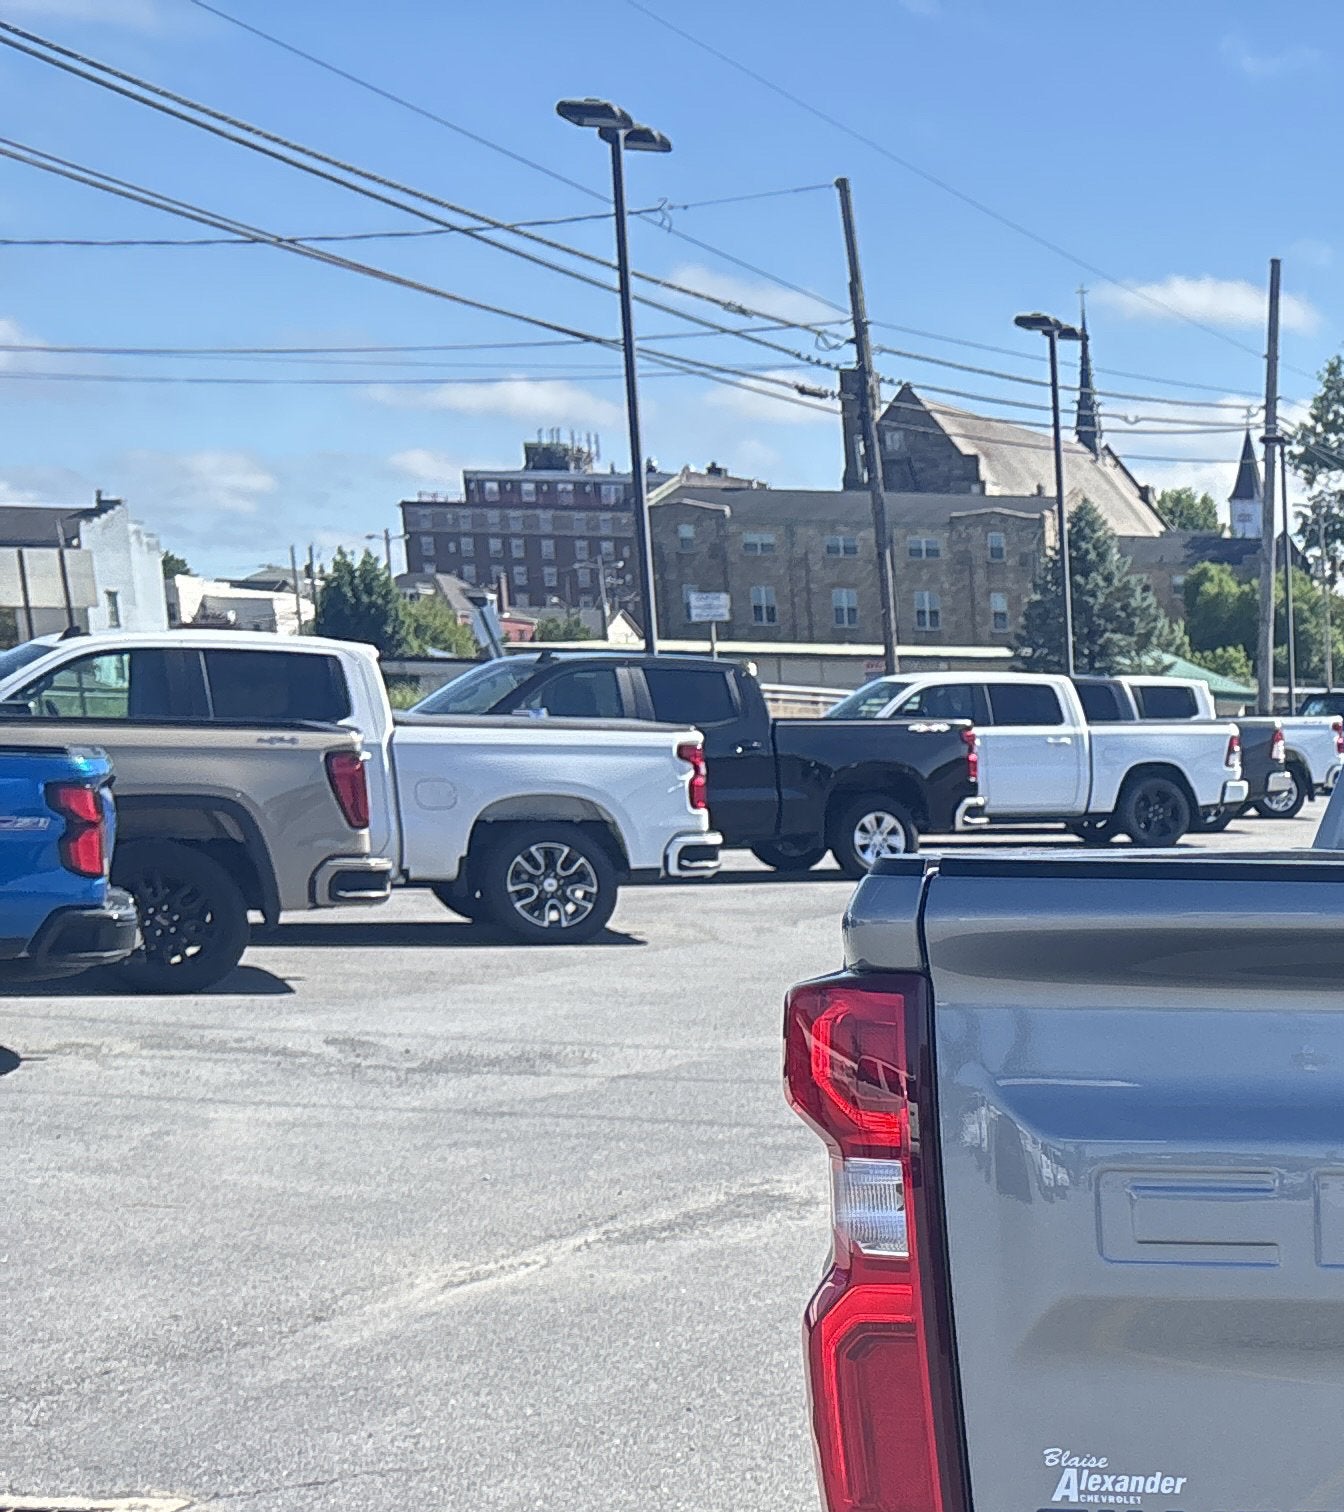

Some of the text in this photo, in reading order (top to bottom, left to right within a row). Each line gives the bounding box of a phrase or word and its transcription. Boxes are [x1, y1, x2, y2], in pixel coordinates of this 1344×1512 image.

[1043, 1447, 1109, 1469] Blaise
[1051, 1468, 1188, 1503] Alexander
[1079, 1494, 1142, 1505] CHEVROLET
